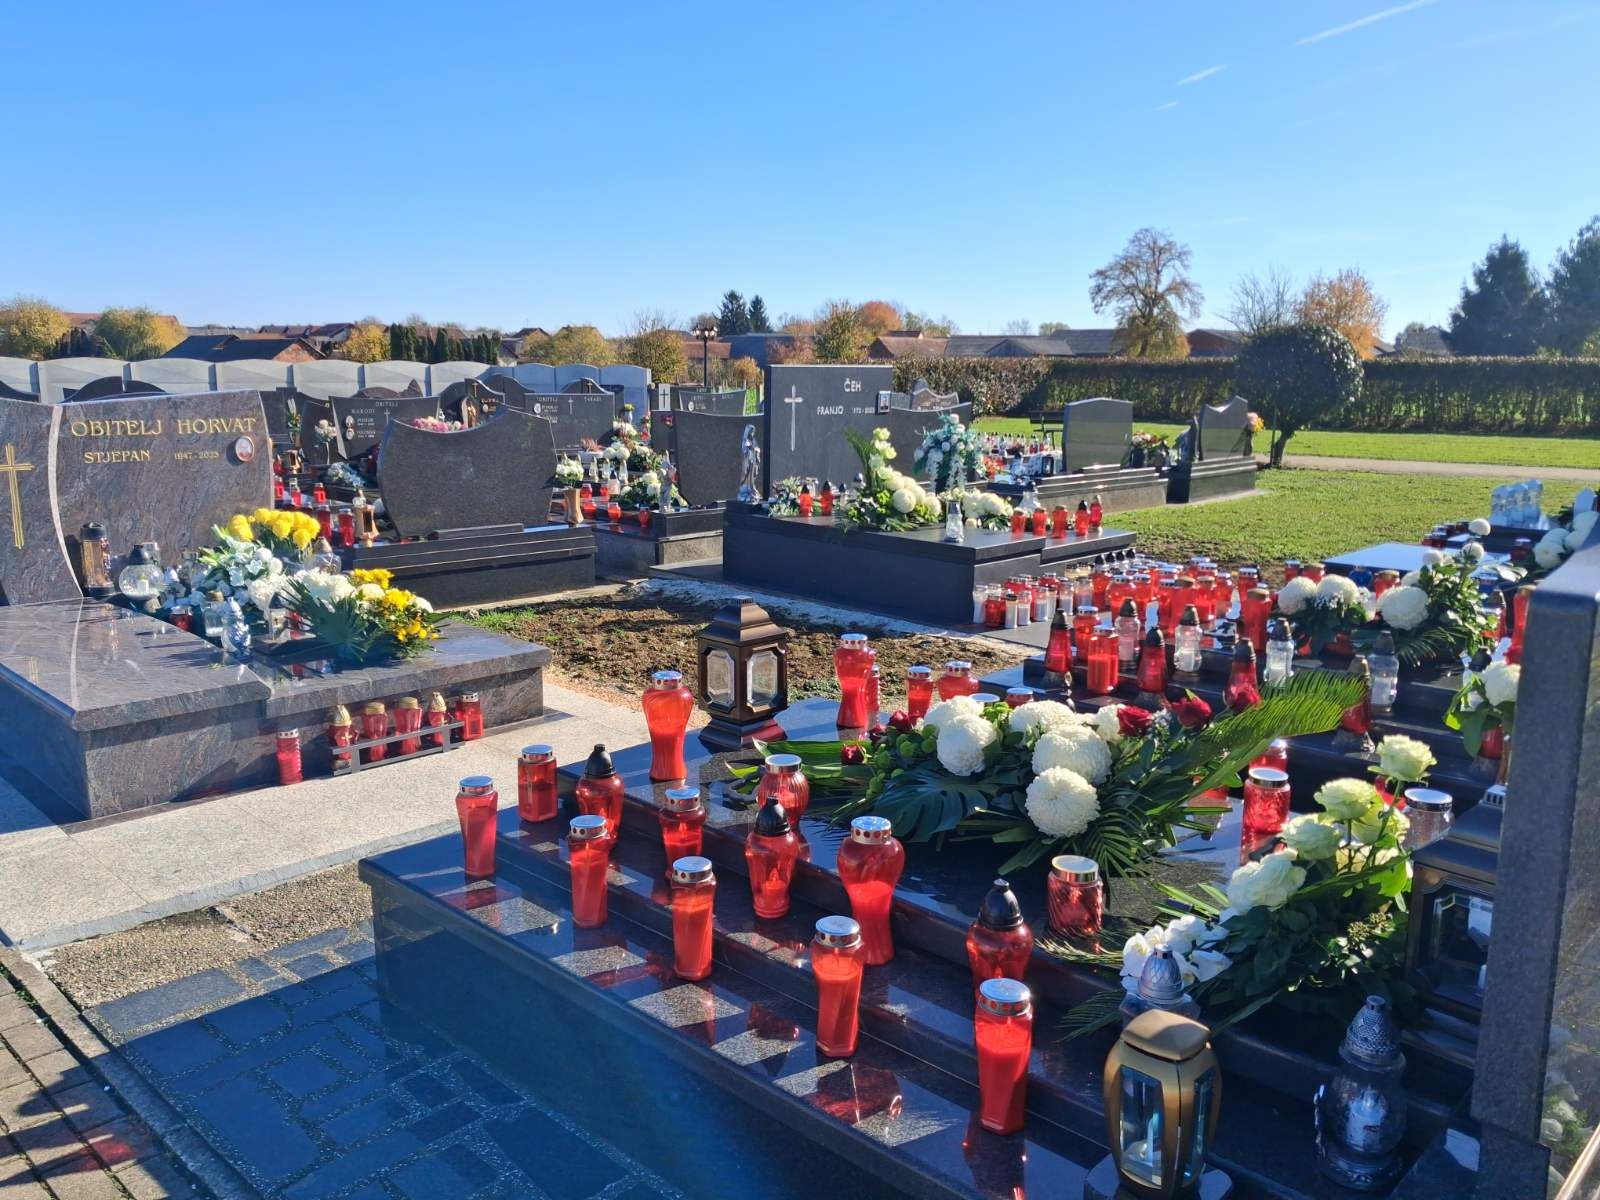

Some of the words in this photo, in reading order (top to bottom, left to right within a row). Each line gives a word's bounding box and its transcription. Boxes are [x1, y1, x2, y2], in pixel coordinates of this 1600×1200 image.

[844, 378, 862, 392] ČEH
[817, 405, 844, 416] FRANJO
[71, 419, 161, 437] OBITELJ
[177, 417, 256, 434] HORVAT
[83, 449, 150, 464] STJEPAN
